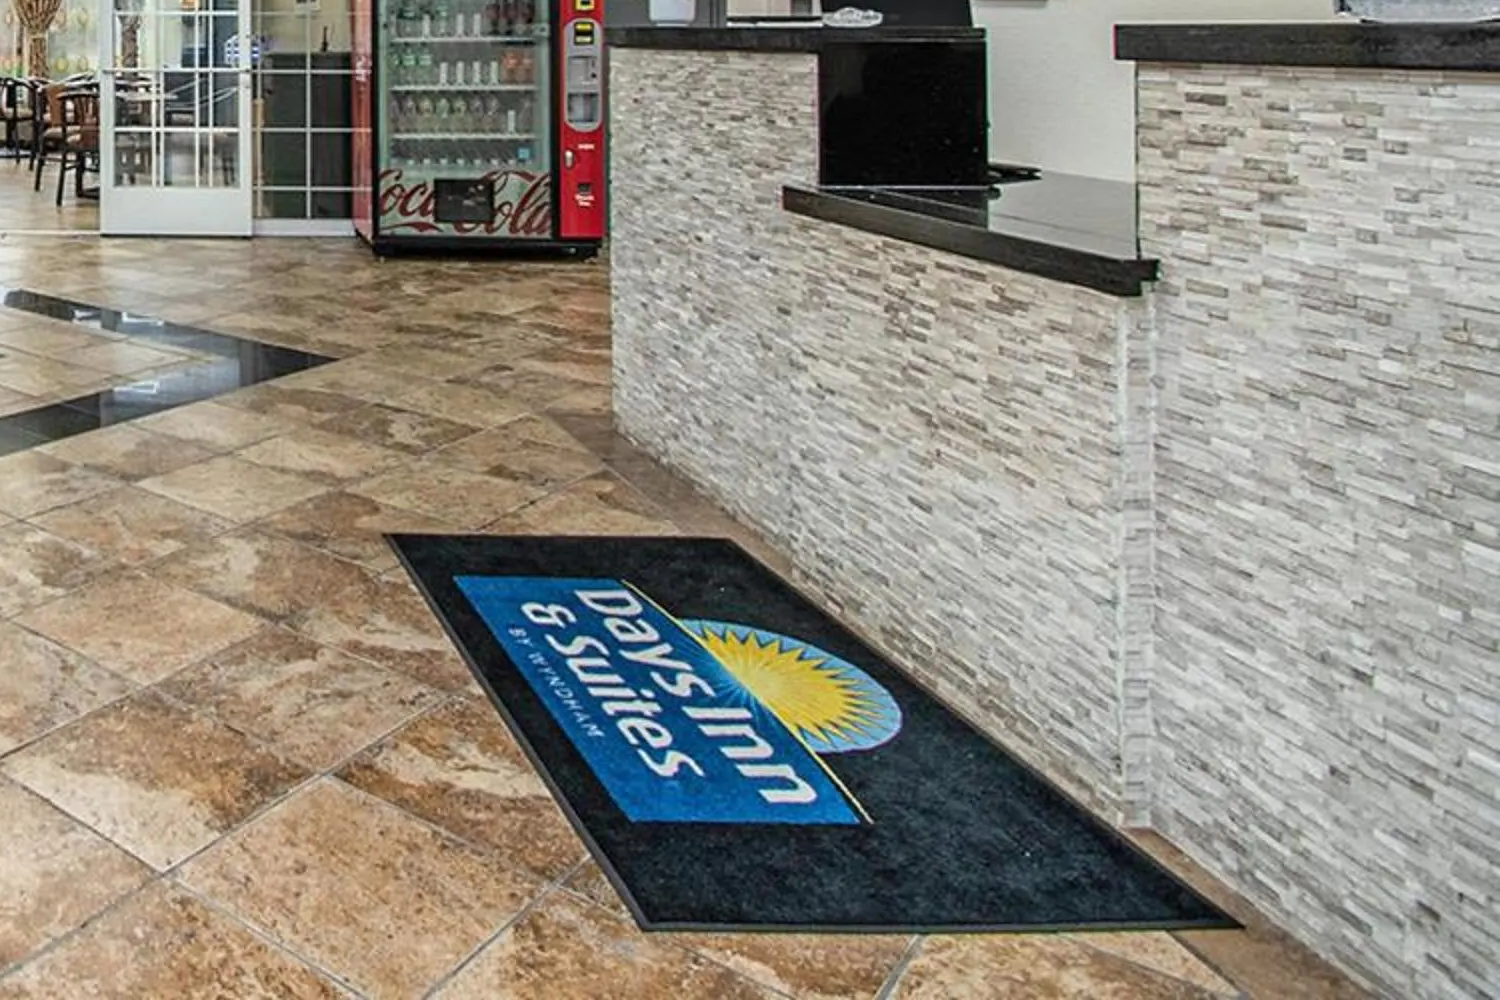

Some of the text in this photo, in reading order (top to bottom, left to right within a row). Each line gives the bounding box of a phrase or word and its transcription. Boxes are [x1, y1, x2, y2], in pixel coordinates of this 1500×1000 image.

[507, 627, 606, 738] BY WYNDHAM
[520, 601, 706, 778] & Suites
[574, 589, 818, 804] Days Inn
